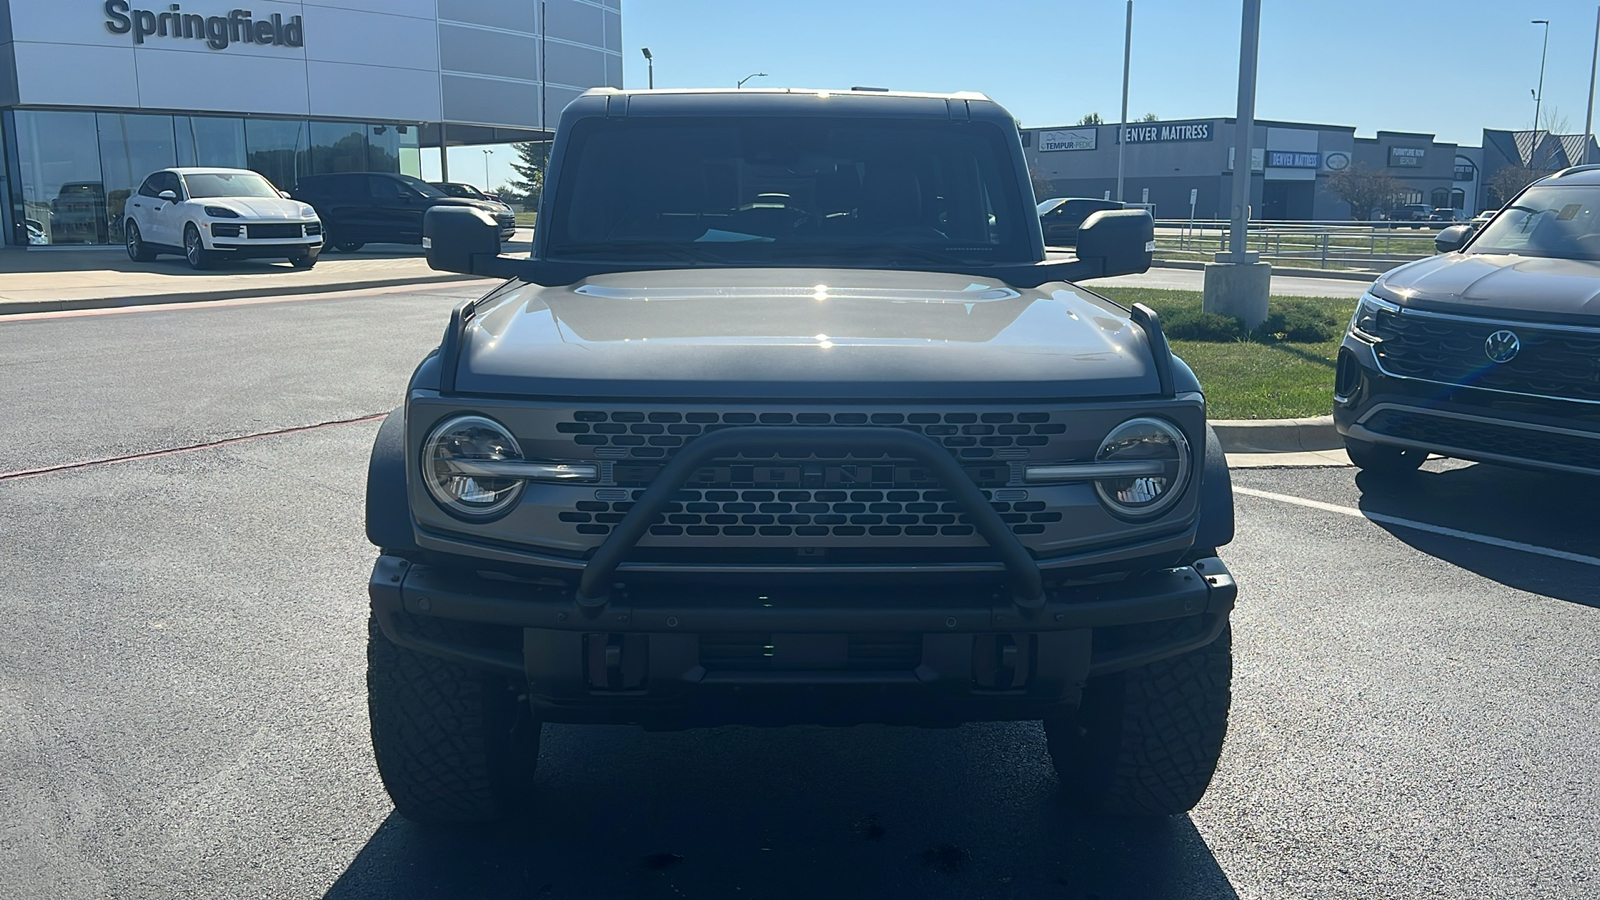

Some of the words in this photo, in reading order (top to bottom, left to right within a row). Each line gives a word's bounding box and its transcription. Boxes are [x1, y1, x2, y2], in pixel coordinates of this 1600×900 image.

[105, 0, 304, 49] Springfield
[1161, 124, 1208, 140] MATTRESS
[1272, 153, 1293, 166] DENVER
[1294, 154, 1317, 166] MATTRESS
